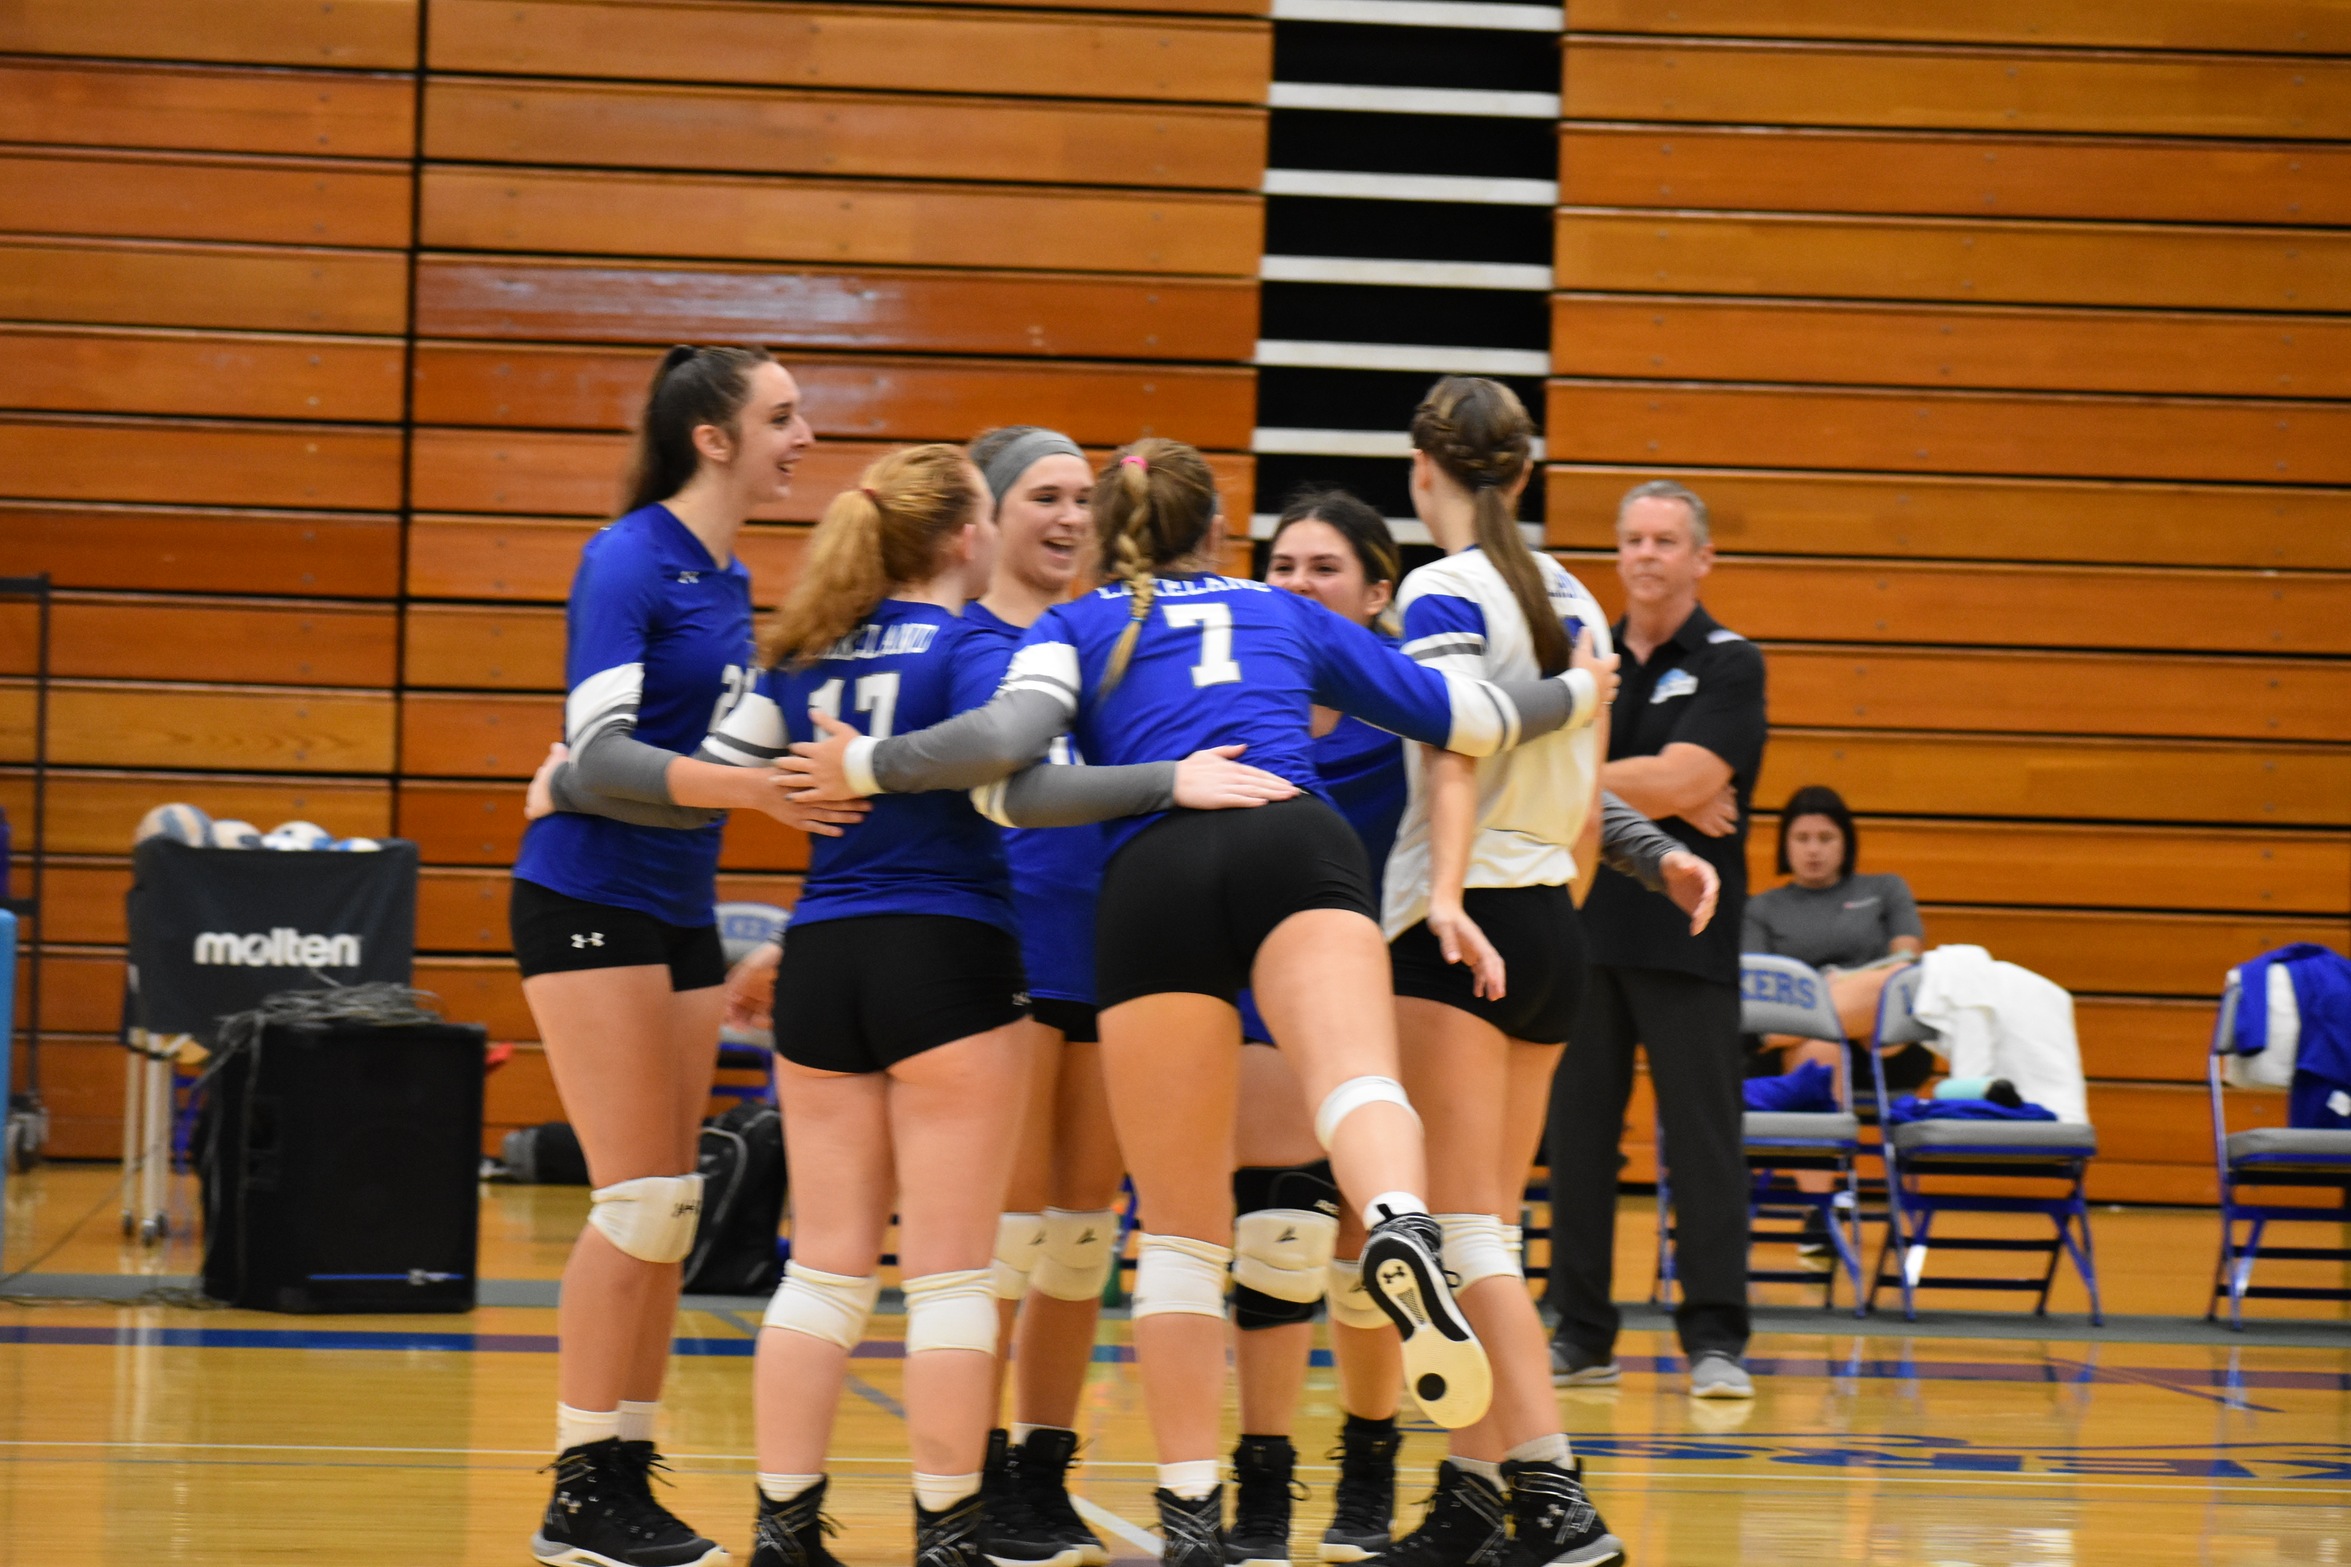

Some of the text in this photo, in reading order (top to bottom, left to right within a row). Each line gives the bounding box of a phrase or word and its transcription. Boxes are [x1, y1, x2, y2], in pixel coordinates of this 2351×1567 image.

[1161, 602, 1242, 688] 7
[807, 671, 902, 743] 17
[193, 927, 360, 967] molten
